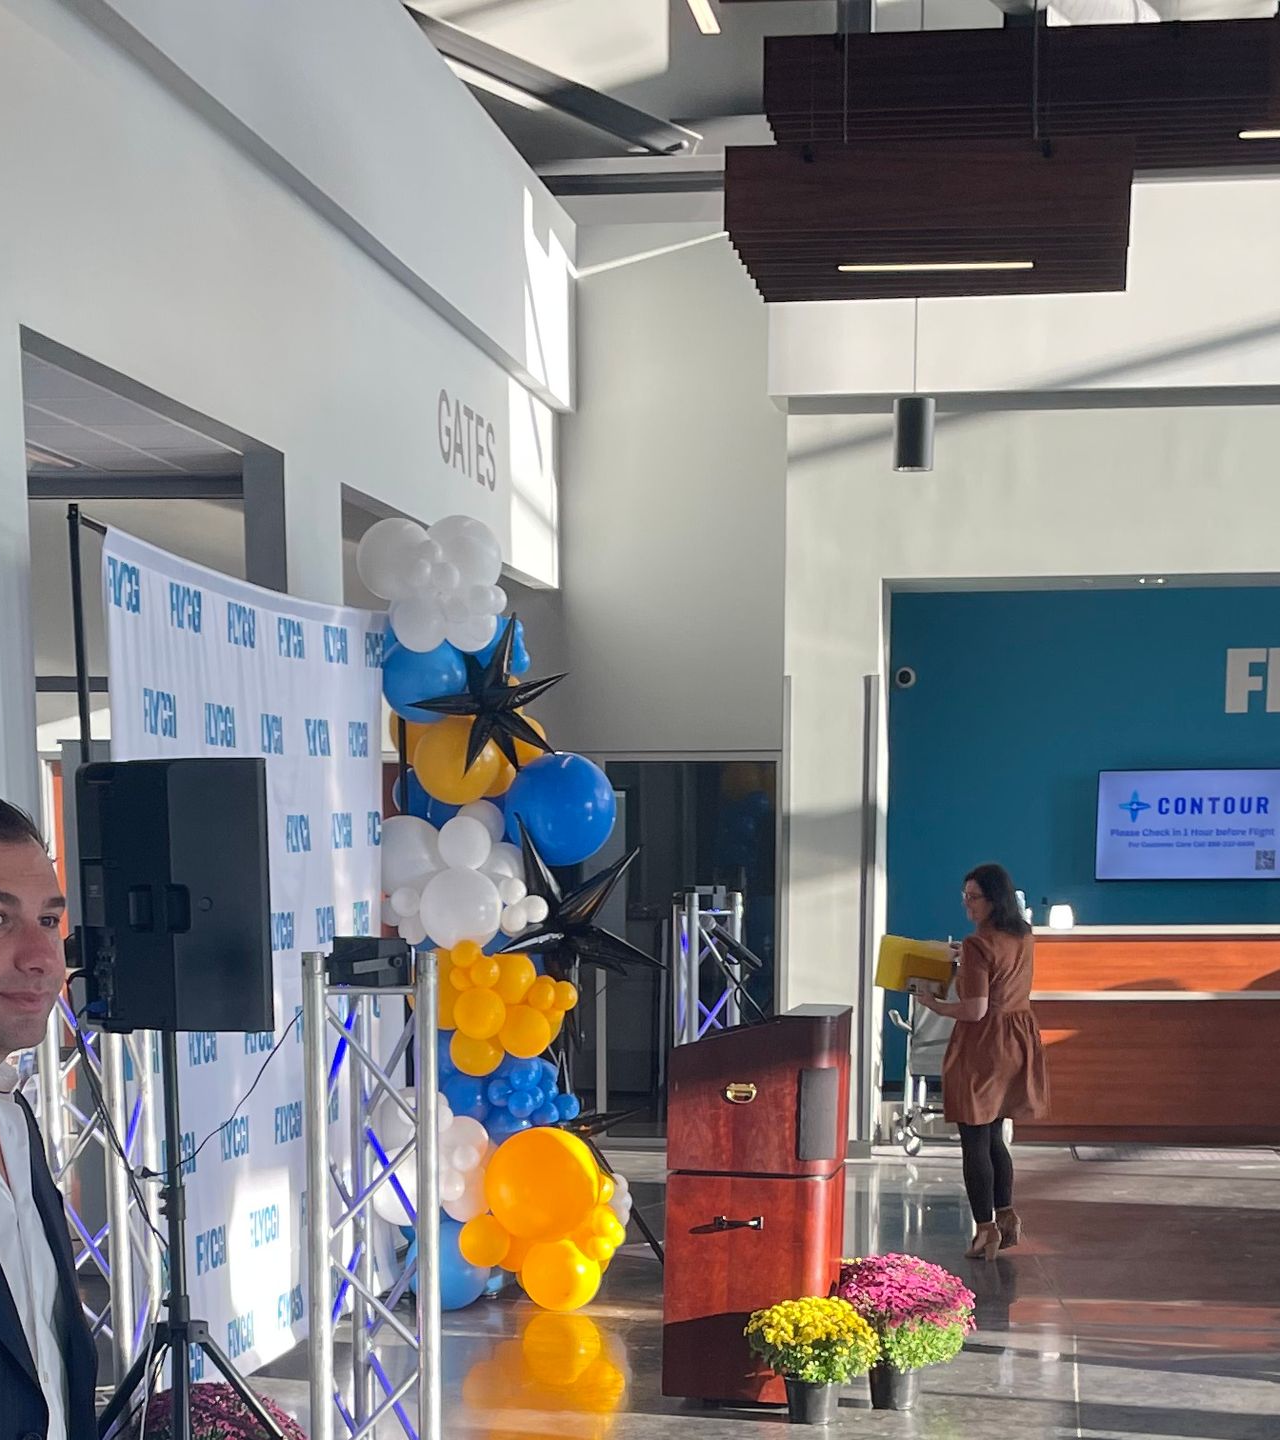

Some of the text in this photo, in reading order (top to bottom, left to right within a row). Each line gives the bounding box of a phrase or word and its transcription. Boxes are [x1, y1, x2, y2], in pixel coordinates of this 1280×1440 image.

[438, 388, 496, 492] GATES
[1158, 796, 1269, 815] CONTOUR
[1110, 829, 1140, 837] Please
[1142, 828, 1170, 837] Check
[1191, 828, 1214, 836] Hour
[1216, 827, 1247, 836] before
[1249, 827, 1275, 838] Flight
[275, 1101, 303, 1145] FLYCGI
